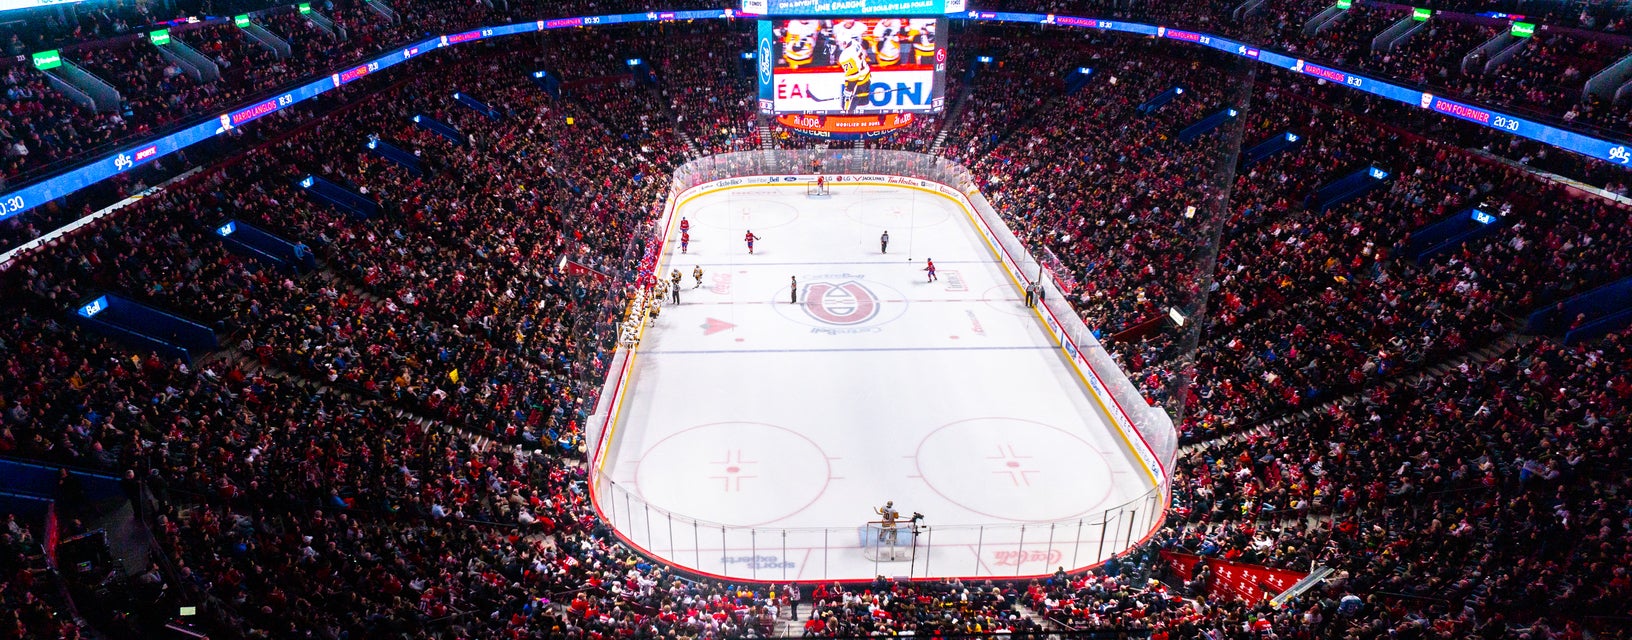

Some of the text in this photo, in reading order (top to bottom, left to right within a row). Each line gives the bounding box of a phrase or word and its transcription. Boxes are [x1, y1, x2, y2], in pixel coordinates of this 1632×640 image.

[936, 63, 945, 72] LG
[233, 109, 251, 124] MARIO
[251, 99, 277, 117] LANGLOIS
[1436, 100, 1519, 131] RON FOURNIER 20:30
[1477, 211, 1490, 225] Bell
[85, 300, 101, 317] Bell
